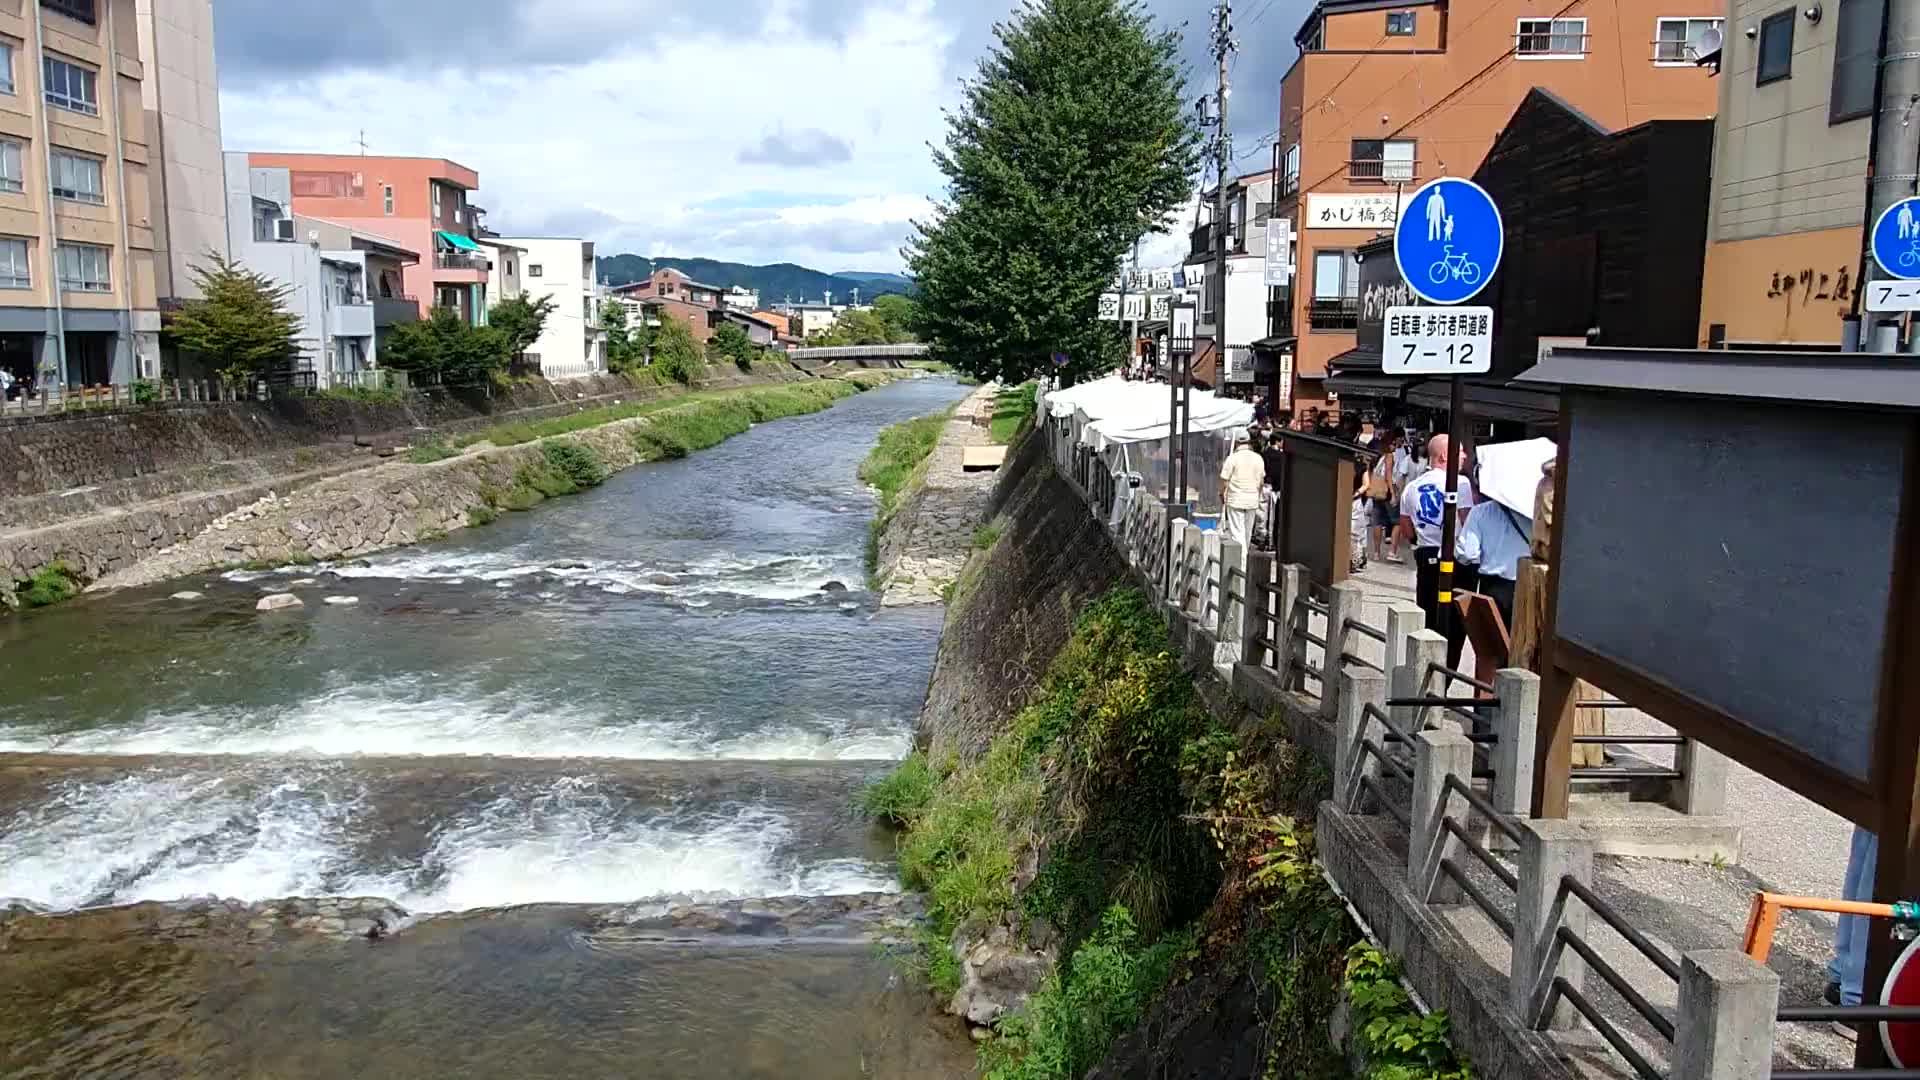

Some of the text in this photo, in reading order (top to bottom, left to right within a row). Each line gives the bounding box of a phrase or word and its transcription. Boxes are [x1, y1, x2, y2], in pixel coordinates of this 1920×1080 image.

[1320, 206, 1396, 222] かじ橋食
[1878, 287, 1920, 304] 7-
[1103, 297, 1174, 316] 宮川朝
[1390, 313, 1488, 336] 自転車・歩行者用道路
[1402, 343, 1474, 365] 7-12
